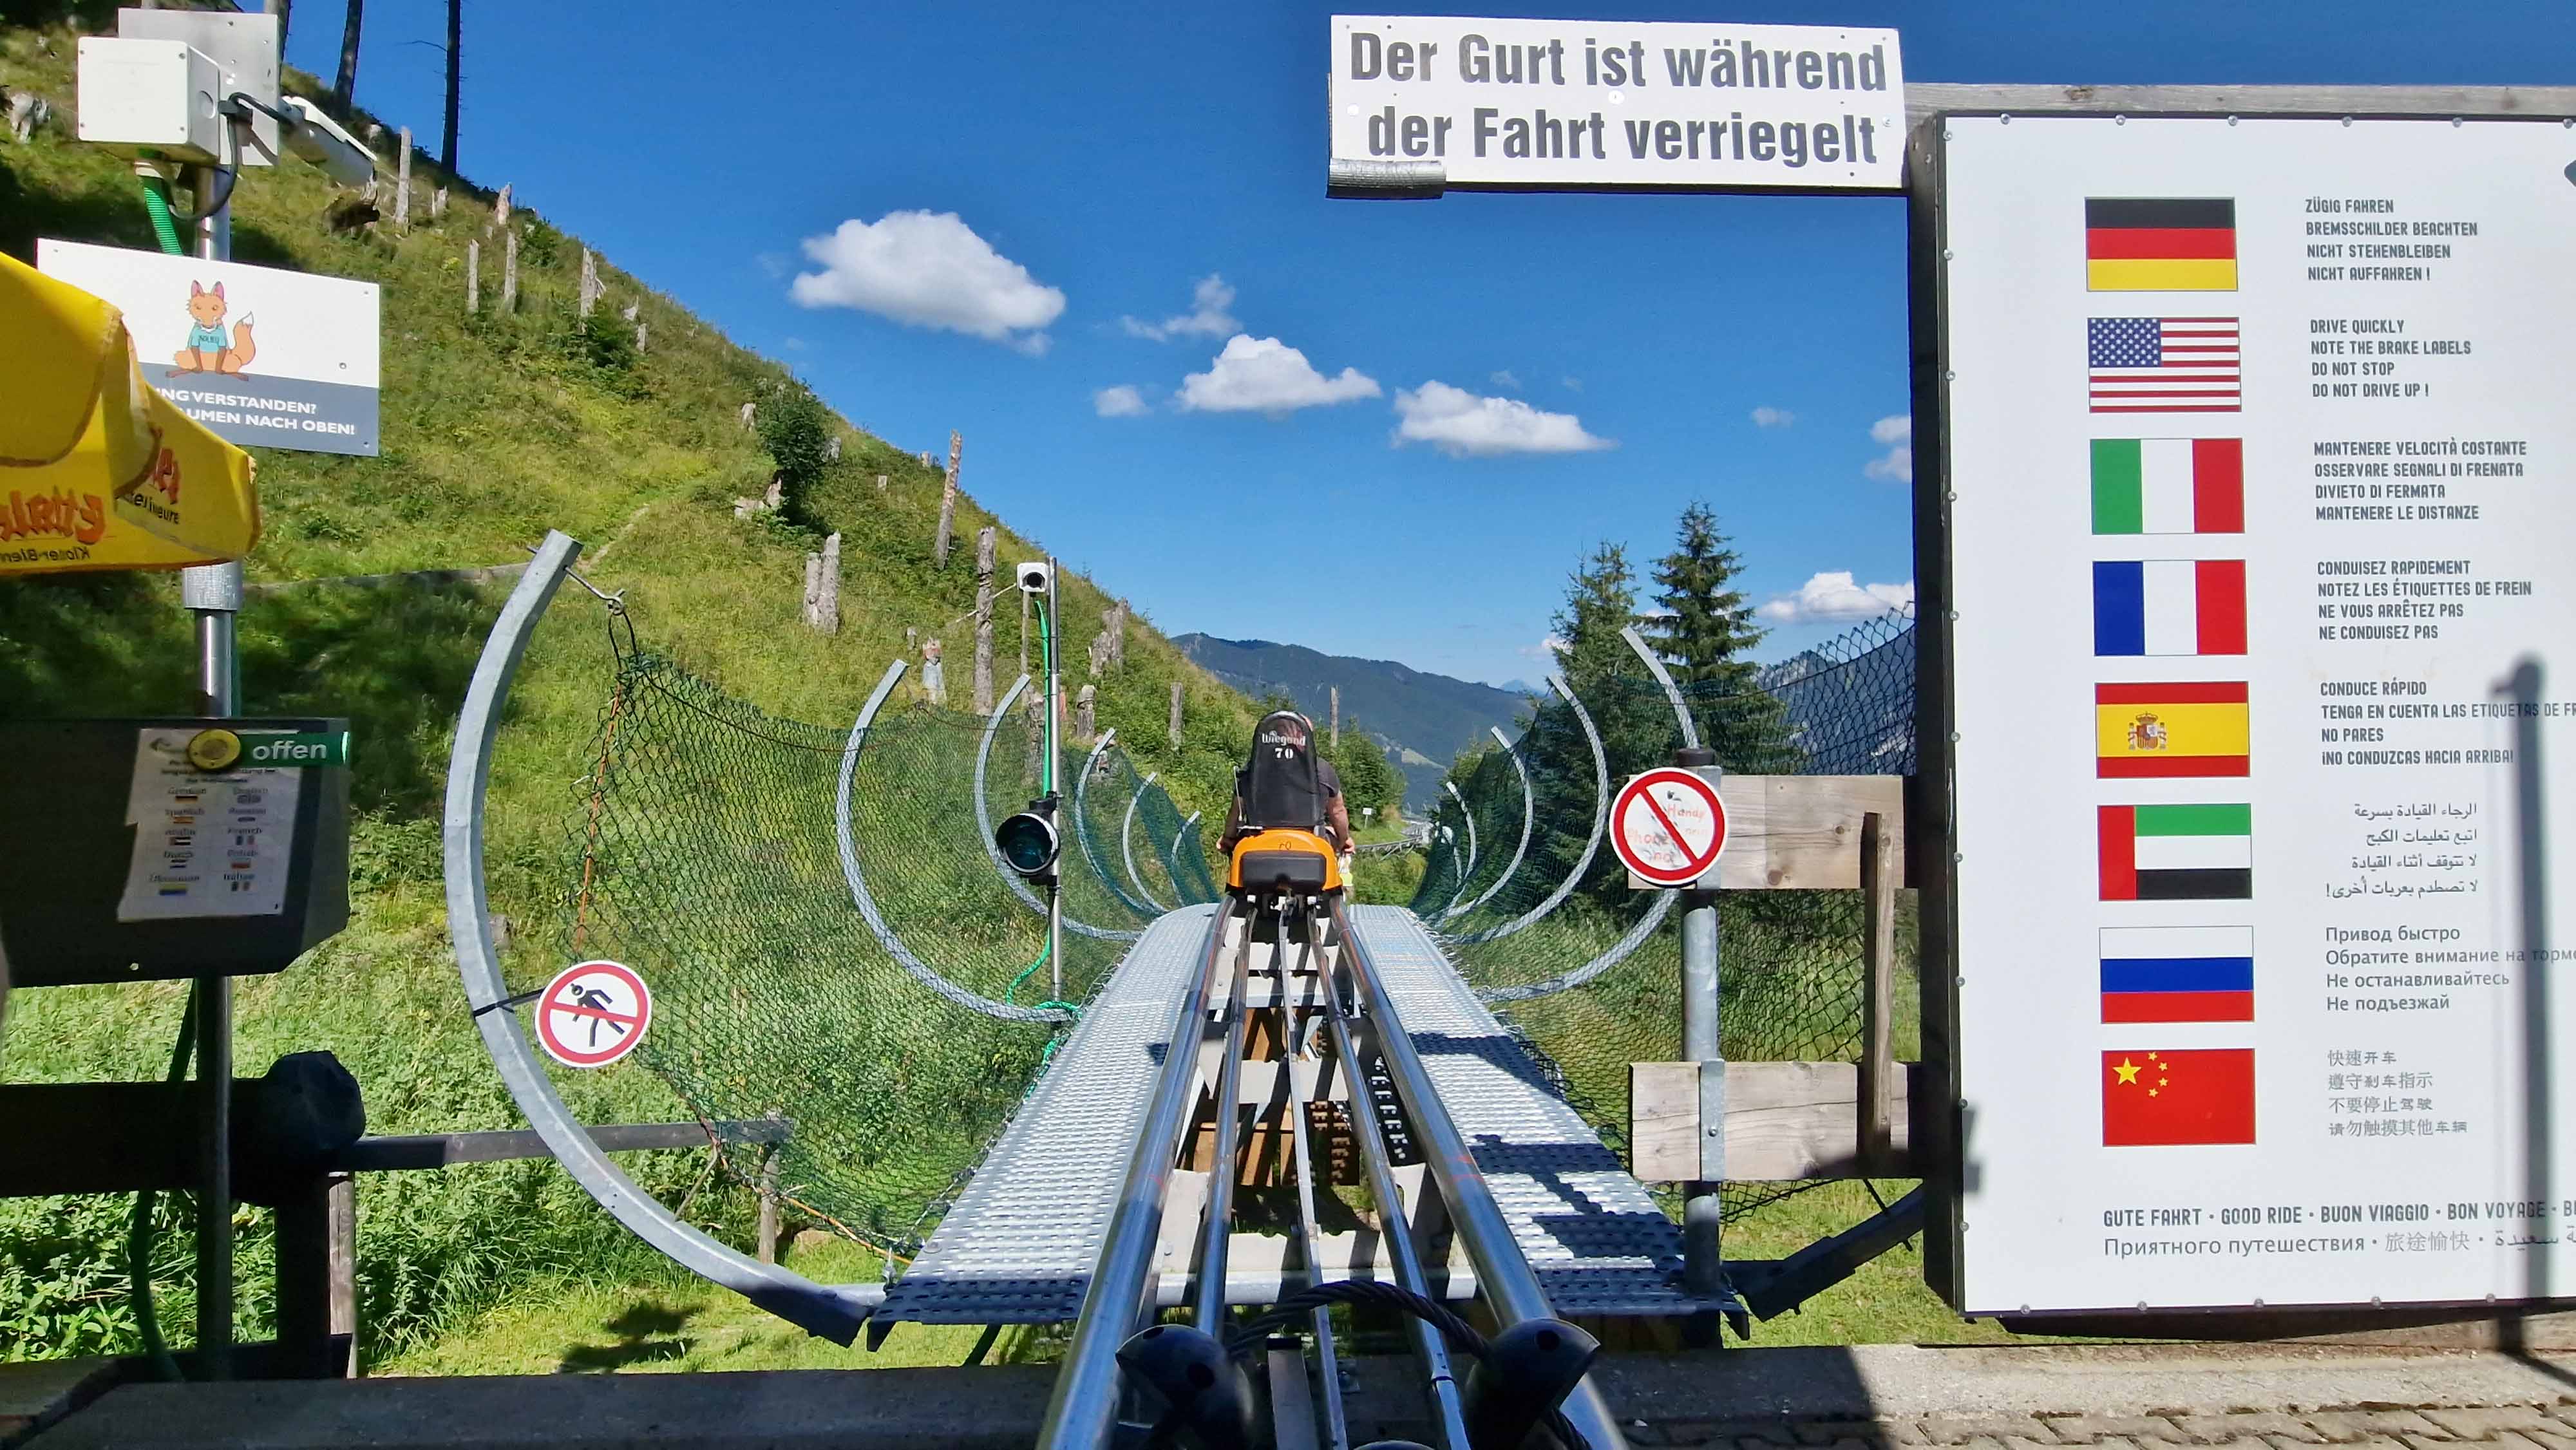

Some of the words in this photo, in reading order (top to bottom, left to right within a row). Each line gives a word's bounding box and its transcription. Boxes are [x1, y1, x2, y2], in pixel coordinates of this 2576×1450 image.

[1350, 32, 1437, 80] Der
[1459, 34, 1564, 84] Gurt
[1586, 38, 1645, 87] ist
[1664, 40, 1887, 91] während
[1368, 106, 1452, 157] der
[1473, 108, 1605, 160] Fahrt
[1624, 114, 1877, 168] verriegelt
[2306, 196, 2340, 212] ZÜGIG
[2345, 200, 2393, 213] FAHREN
[2306, 221, 2407, 235] BREMSSCHILDER
[2413, 222, 2477, 236] BEACHTEN
[2307, 245, 2343, 258] NICHT
[2349, 245, 2450, 258] STEHENBLEIBEN
[2308, 267, 2344, 280] NICHT
[2350, 267, 2421, 281] AUFFAHREN
[2311, 319, 2347, 333] DRIVE
[2353, 320, 2403, 335] QUICKLY
[2311, 341, 2344, 354] NOTE
[2349, 341, 2372, 354] THE
[2378, 341, 2418, 354] BRAKE
[2424, 341, 2470, 354] LABELS
[2312, 362, 2327, 375] DO
[2333, 362, 2356, 375] NOT
[2363, 362, 2394, 375] STOP
[2313, 384, 2327, 397] DO
[2333, 384, 2357, 397] NOT
[2363, 384, 2400, 397] DRIVE
[2405, 384, 2420, 397] UP
[192, 392, 316, 414] VERSTANDEN?
[245, 415, 297, 429] NACH
[302, 421, 355, 435] OBEN!
[2315, 442, 2391, 455] MANTENERE
[2396, 437, 2457, 455] VELOCITÀ
[2462, 441, 2526, 455] COSTANTE
[2315, 463, 2388, 477] OSSERVARE
[2394, 463, 2445, 476] SEGNALI
[2450, 463, 2461, 476] DI
[2467, 463, 2523, 476] FRENATA
[2316, 485, 2365, 498] DIVIETO
[2370, 485, 2381, 498] DI
[2387, 485, 2445, 498] FERMATA
[2316, 506, 2392, 520] MANTENERE
[2398, 506, 2413, 520] LE
[2418, 505, 2479, 519] DISTANZE
[2318, 561, 2386, 575] CONDUISEZ
[2392, 561, 2470, 574] RAPIDEMENT
[2318, 583, 2359, 596] NOTEZ
[2365, 583, 2387, 596] LES
[2393, 578, 2470, 597] ÉTIQUETTES
[2476, 582, 2490, 596] DE
[2496, 581, 2531, 595] FREIN
[2319, 605, 2334, 618] NE
[2341, 605, 2372, 618] VOUS
[2378, 599, 2434, 617] ARRÊTEZ
[2440, 604, 2463, 617] PAS
[2320, 626, 2336, 639] NE
[2341, 625, 2409, 639] CONDUISEZ
[2414, 625, 2438, 639] PAS
[2321, 682, 2377, 695] CONDUCE
[2383, 677, 2426, 695] RÁPIDO
[2322, 705, 2362, 719] TENGA
[2368, 705, 2383, 719] EN
[2389, 704, 2438, 718] CUENTA
[2443, 704, 2466, 717] LAS
[2472, 703, 2539, 719] ETIQUETAS
[2544, 703, 2559, 717] DE
[2322, 729, 2338, 742] NO
[2344, 728, 2383, 742] PARES
[252, 740, 327, 760] offen
[1274, 748, 1293, 758] 70
[2348, 751, 2420, 764] CONDUZCAS
[2425, 750, 2460, 764] HACIA
[2466, 749, 2514, 764] ARRIBA!
[2354, 804, 2392, 820] بسرعة
[2397, 804, 2436, 820] القيادة
[2442, 804, 2476, 819] الرجاء
[2367, 829, 2398, 846] الكبح
[2403, 829, 2449, 845] تعليمات
[2454, 829, 2476, 845] اتبع
[2353, 855, 2391, 871] القيادة
[2397, 854, 2422, 867] أثناء
[2427, 855, 2463, 870] تتوقف
[2469, 854, 2476, 866] لا
[2372, 881, 2414, 897] بعربات
[2418, 880, 2465, 899] تصطدم
[2470, 880, 2477, 892] لا
[2326, 927, 2392, 944] Привод
[2398, 925, 2459, 943] быстро
[2326, 950, 2408, 967] Обратите
[2416, 950, 2499, 963] внимание
[2506, 950, 2524, 961] на
[2327, 974, 2348, 987] Не
[2355, 971, 2509, 987] останавливайтесь
[2327, 997, 2348, 1010] Не
[2356, 994, 2448, 1012] подъезжай
[2328, 1050, 2396, 1066] 快速开车
[2329, 1096, 2433, 1113] 不要停止驾驶
[2104, 1210, 2144, 1227] GUTE
[2152, 1209, 2201, 1226] FAHRT
[2222, 1207, 2260, 1225] GOOD
[2268, 1207, 2302, 1223] RIDE
[2322, 1205, 2362, 1223] BUON
[2369, 1204, 2429, 1221] VIAGGIO
[2448, 1203, 2477, 1219] BON
[2486, 1201, 2546, 1218] VOYAGE
[2105, 1239, 2221, 1259] Приятного
[2230, 1238, 2363, 1257] путешествия
